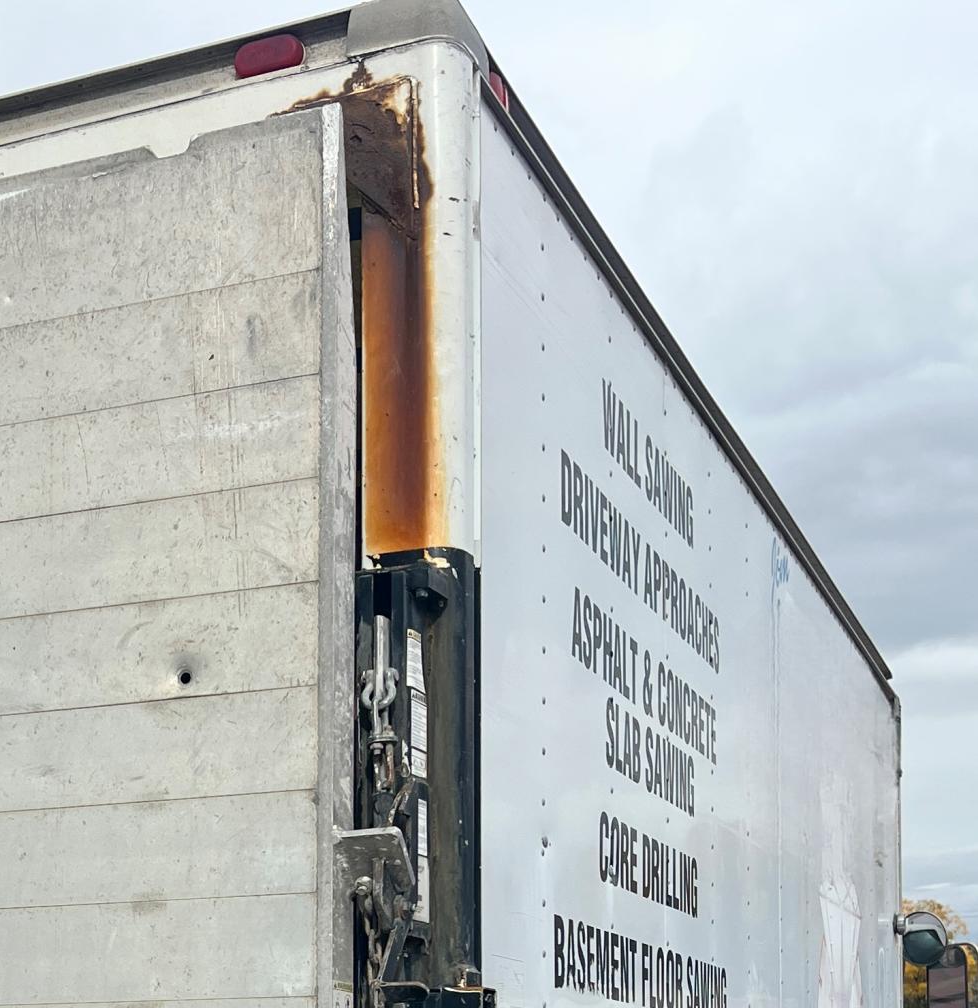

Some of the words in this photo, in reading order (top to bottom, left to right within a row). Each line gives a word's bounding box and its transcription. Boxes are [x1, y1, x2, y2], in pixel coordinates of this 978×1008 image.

[602, 377, 642, 489] WALL
[644, 435, 694, 549] SAWING
[561, 448, 641, 595] DRIVEWAY
[643, 543, 719, 674] APPROACHES
[572, 586, 638, 705] ASPHALT
[643, 650, 653, 718] &
[658, 661, 717, 765] CONCRETE
[606, 697, 641, 784] SLAB
[645, 726, 695, 817] SAWING
[599, 811, 638, 895] CORE
[642, 834, 698, 919] DRILLING
[554, 914, 637, 1004] BASEMENT
